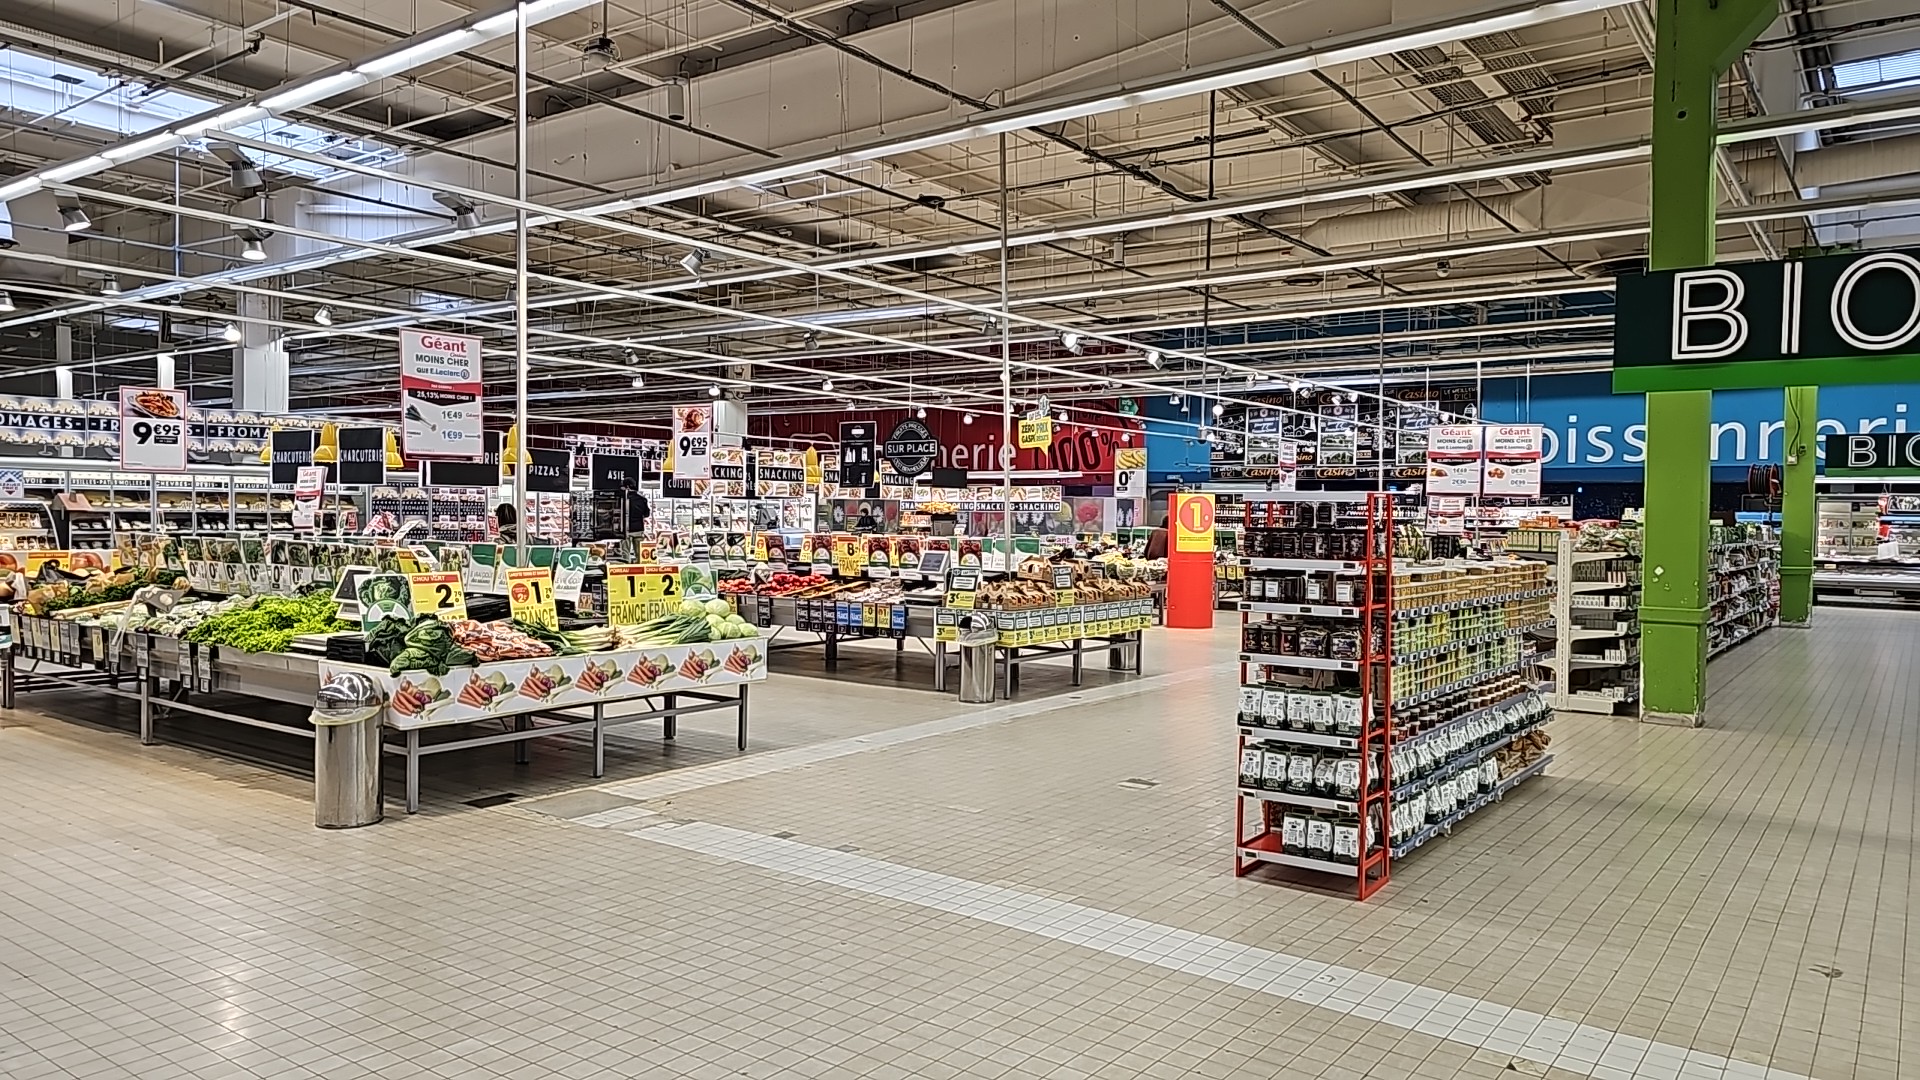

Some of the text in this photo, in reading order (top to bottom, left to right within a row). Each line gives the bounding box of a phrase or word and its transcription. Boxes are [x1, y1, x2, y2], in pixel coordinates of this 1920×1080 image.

[1672, 253, 1920, 360] BIO
[421, 336, 466, 352] Géant
[416, 354, 469, 367] MOINS CHER
[1021, 422, 1035, 433] ZÉRO
[1441, 428, 1472, 436] Géant
[1500, 428, 1531, 436] Géant
[888, 443, 935, 453] SUR PLACE
[273, 451, 312, 464] CHARCUTERIE
[340, 449, 383, 463] CHARCUTERIE
[529, 464, 560, 477] PIZZAS
[608, 470, 625, 480] ASIE
[759, 468, 803, 480] SNACKING
[882, 474, 914, 484] SNACKING
[1190, 503, 1201, 527] 1
[627, 576, 635, 597] 1
[662, 574, 675, 595] 2
[436, 584, 455, 608] 2
[531, 581, 542, 604] 1
[610, 603, 645, 624] FRANCE
